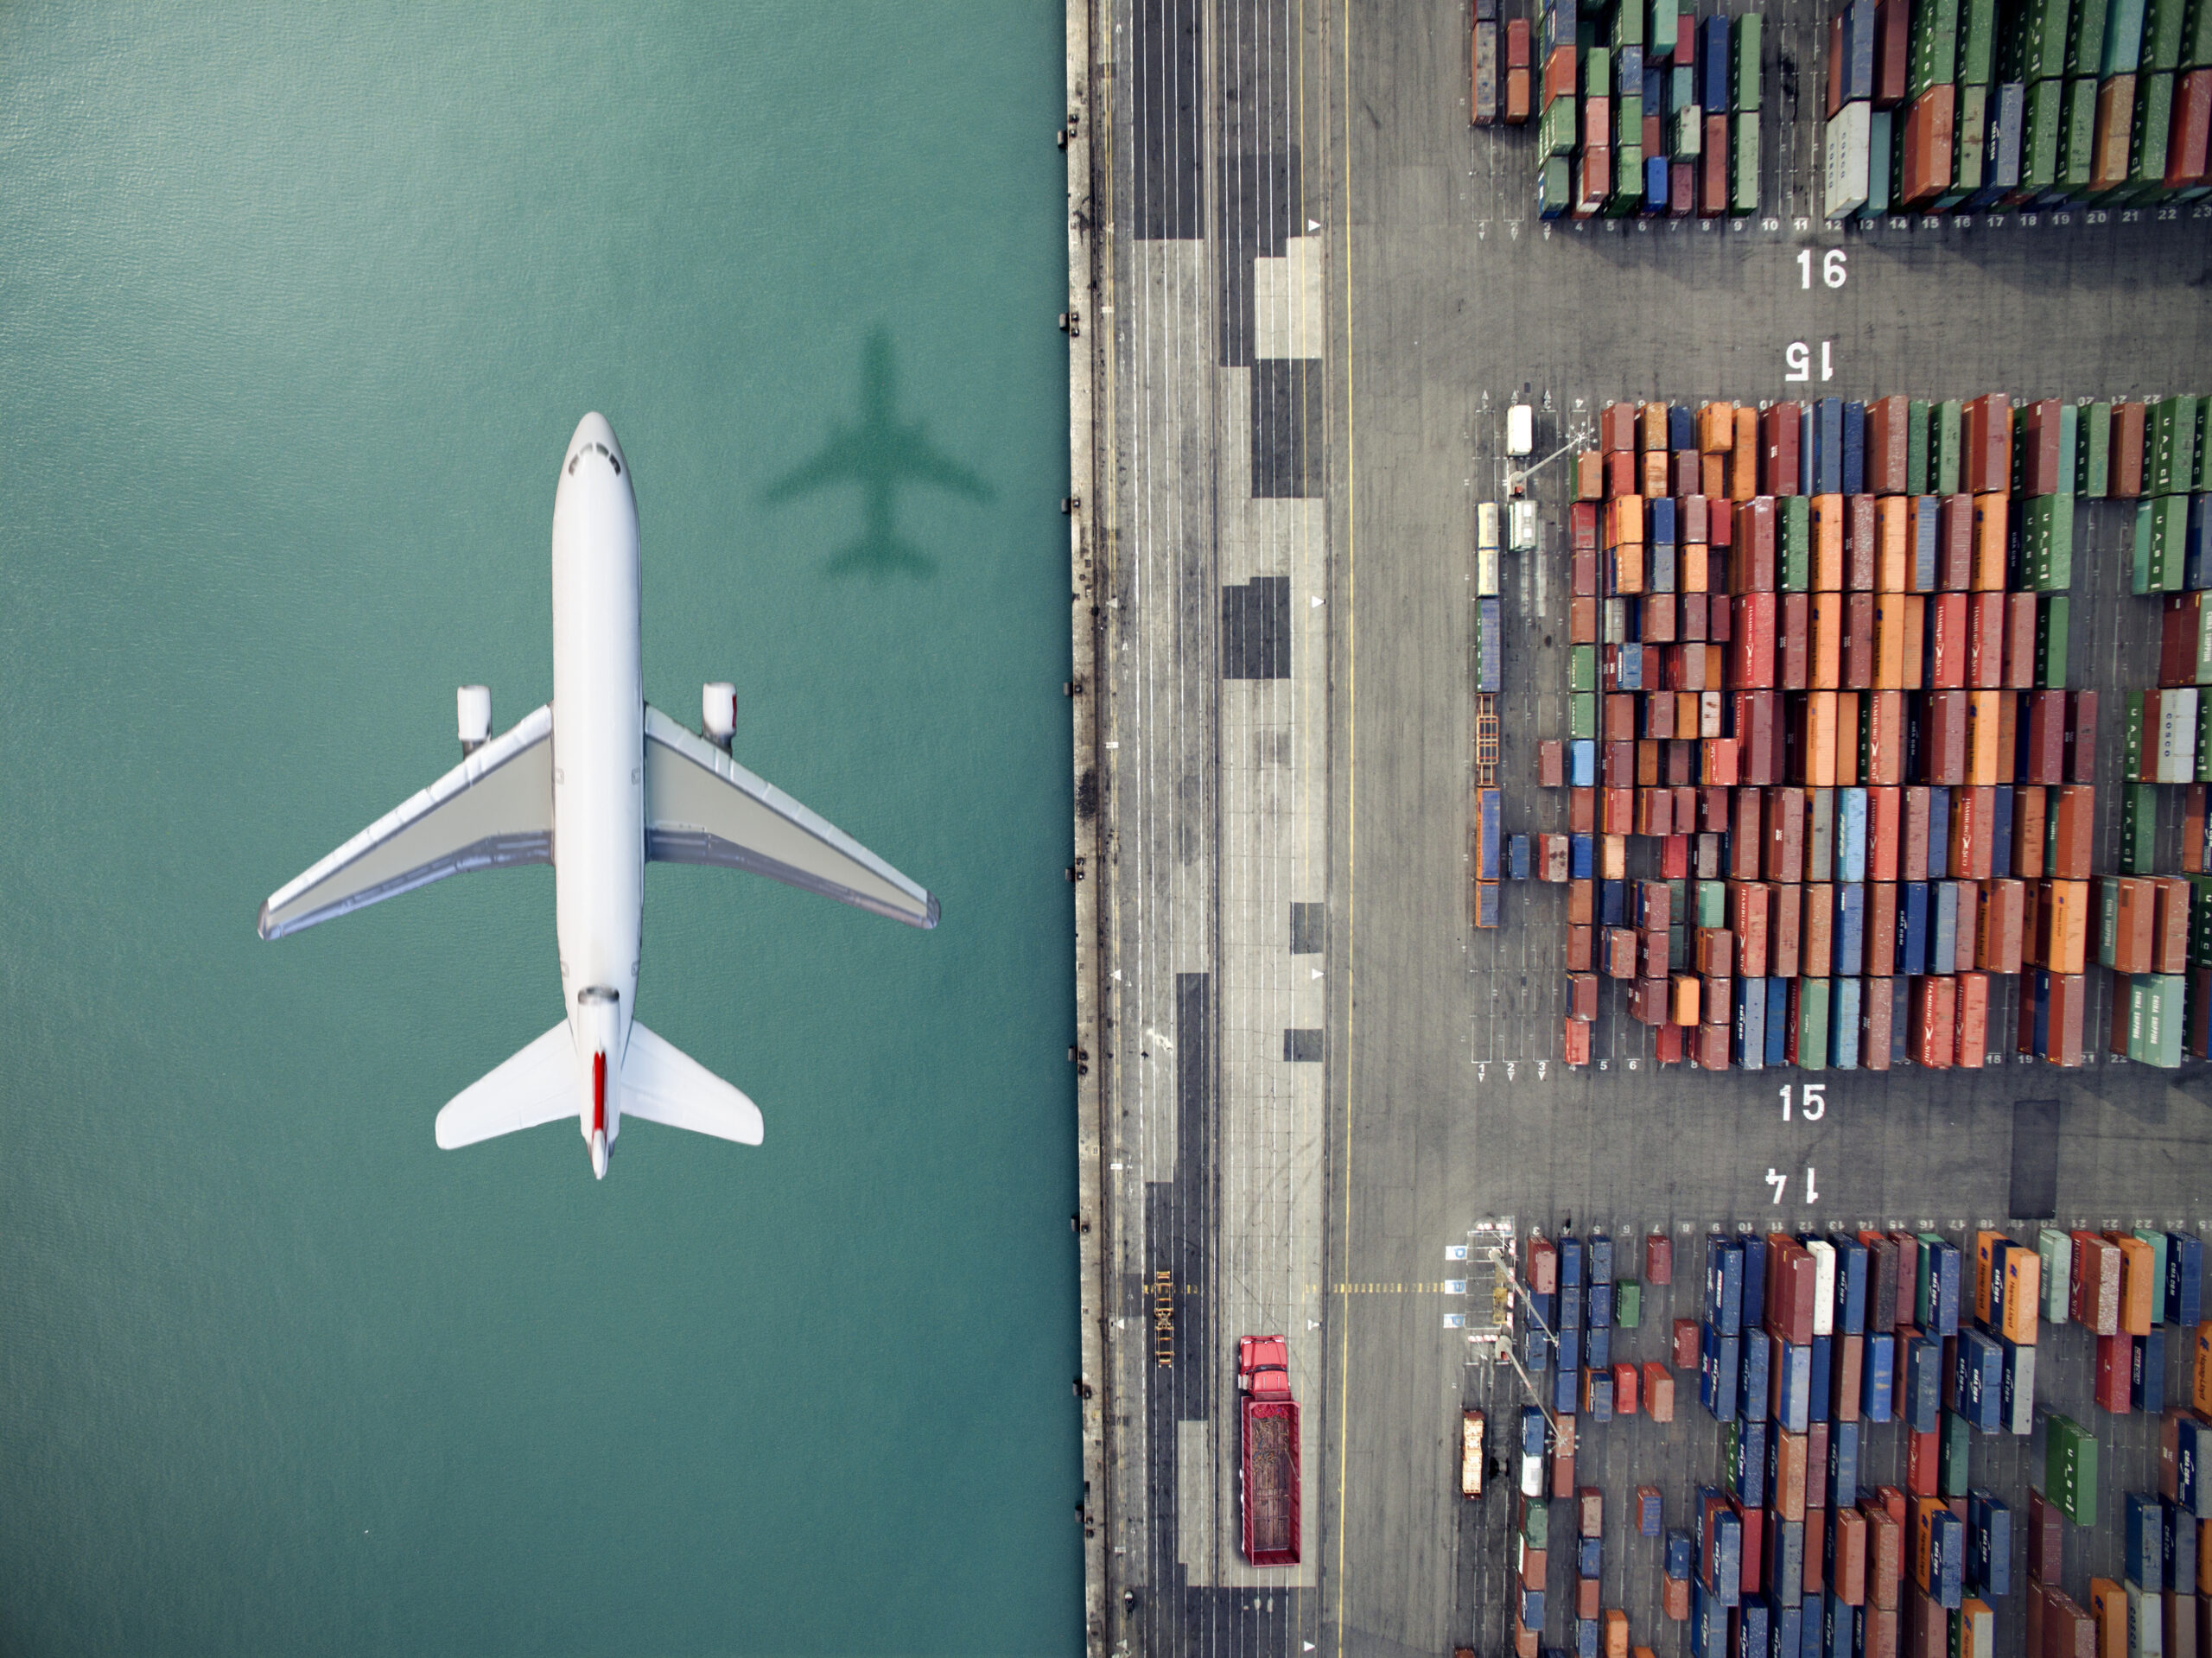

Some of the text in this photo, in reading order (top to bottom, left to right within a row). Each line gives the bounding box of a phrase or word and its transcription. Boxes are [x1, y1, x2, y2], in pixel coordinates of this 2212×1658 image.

[2122, 212, 2139, 221] 21
[2158, 210, 2177, 219] 22
[2193, 207, 2212, 218] 23
[1954, 218, 1971, 228] 16
[1987, 217, 2005, 227] 17
[2020, 216, 2037, 226] 18
[2052, 215, 2069, 225] 19
[2087, 213, 2107, 224] 20
[1575, 222, 1583, 232] 4
[1606, 221, 1615, 232] 5
[1637, 221, 1647, 232] 6
[1670, 222, 1678, 232] 7
[1702, 221, 1710, 231] 8
[1733, 221, 1742, 231] 9
[1762, 220, 1778, 231] 10
[1794, 220, 1808, 231] 11
[1825, 220, 1842, 230] 12
[1860, 220, 1873, 230] 13
[1890, 219, 1907, 229] 14
[1922, 219, 1939, 229] 15
[1796, 249, 1847, 289] 16
[1784, 340, 1834, 383] 15
[1986, 1054, 2001, 1064] 18
[2018, 1055, 2033, 1064] 19
[2111, 1054, 2127, 1064] 22
[1478, 1064, 1484, 1073] 1
[1507, 1063, 1515, 1072] 2
[1538, 1063, 1546, 1072] 3
[1600, 1061, 1608, 1070] 5
[1629, 1061, 1637, 1070] 6
[1778, 1083, 1826, 1121] 15
[1765, 1168, 1819, 1204] 14
